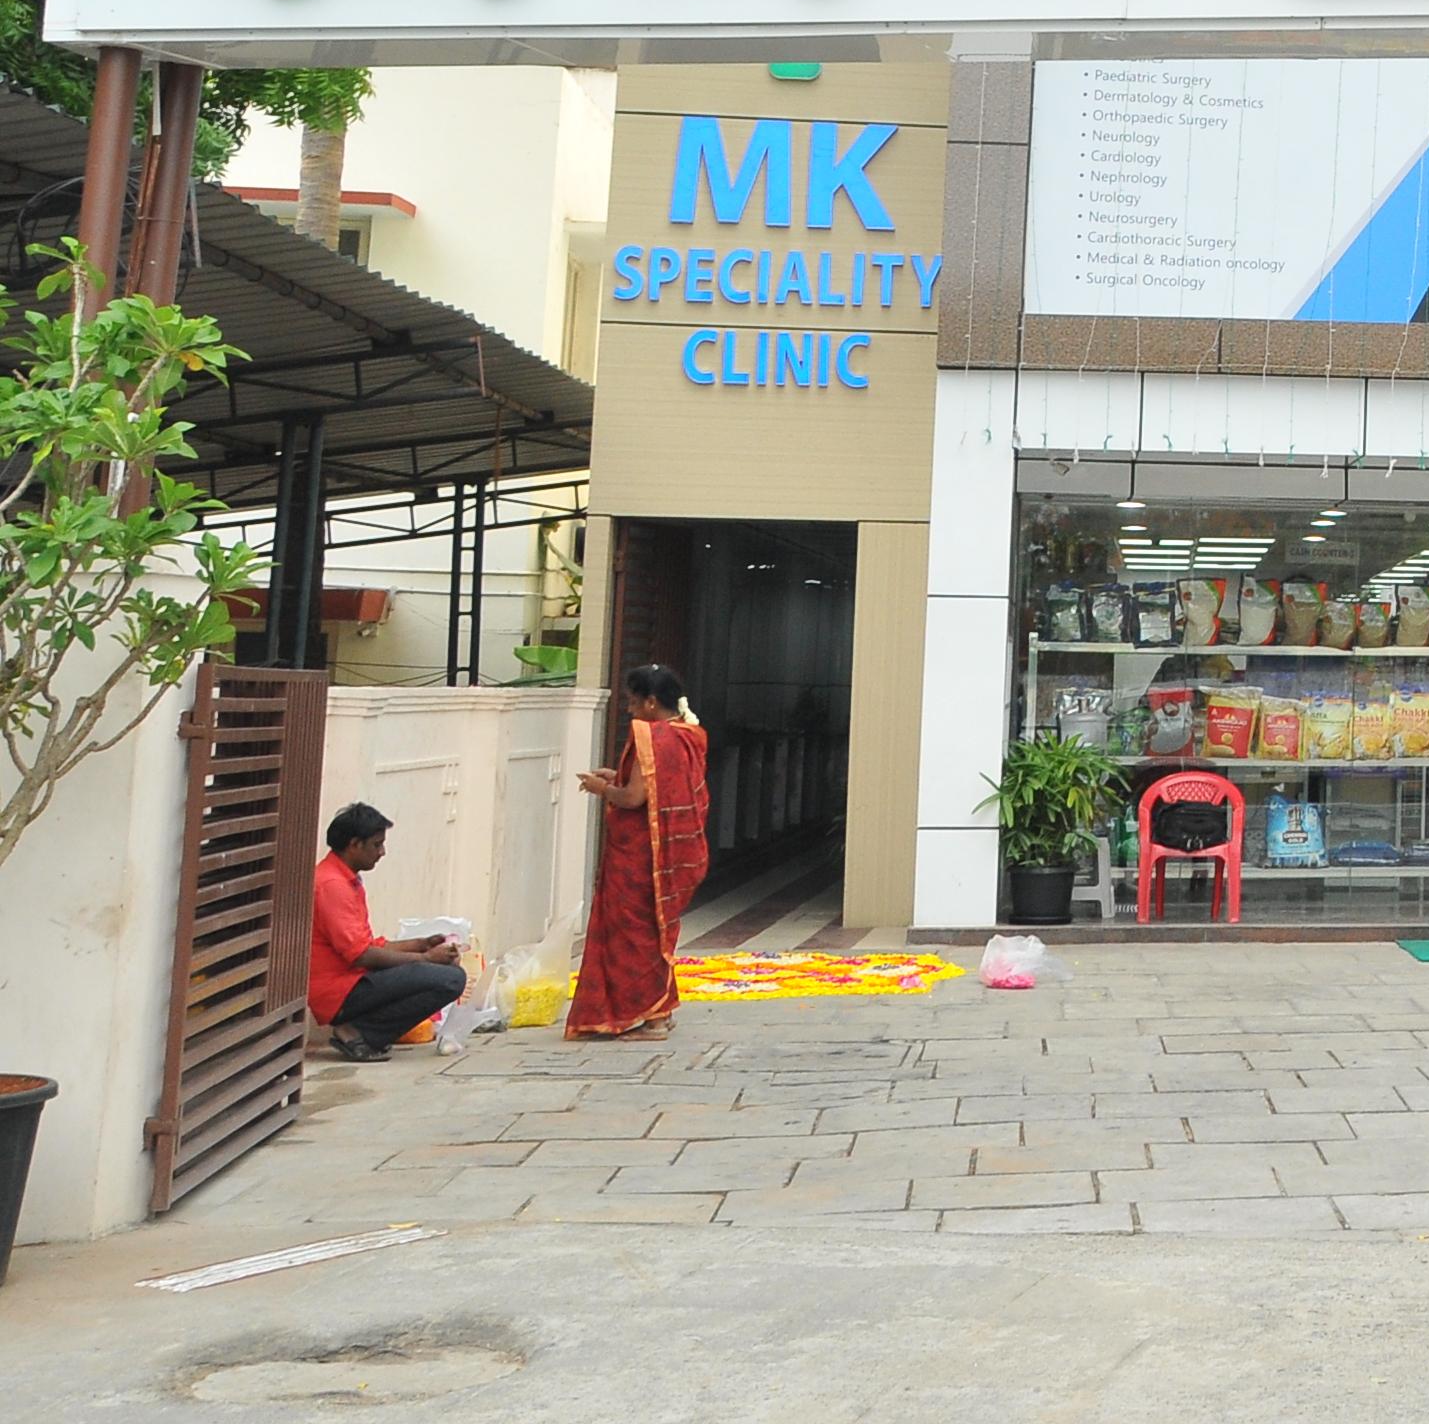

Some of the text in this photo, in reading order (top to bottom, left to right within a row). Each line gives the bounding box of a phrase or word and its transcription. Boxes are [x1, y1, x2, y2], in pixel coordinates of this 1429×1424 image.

[1095, 69, 1212, 89] Paediatric Surgery
[1094, 89, 1264, 109] Dermatology & Cosmetics
[1092, 109, 1228, 129] Orthopaedic Surgery
[1092, 130, 1160, 146] Neurology
[1090, 149, 1161, 166] Cardiology
[669, 114, 898, 231] MK
[1090, 170, 1168, 187] Nephrology
[1089, 190, 1142, 207] Urology
[1088, 211, 1178, 228] Neurosurgery
[1087, 231, 1237, 251] Cardiothoracic Surgery
[1087, 252, 1286, 273] Medical & Radiation oncology
[613, 244, 944, 309] SPECIALITY
[1086, 272, 1206, 290] Surgical Oncology
[682, 328, 871, 389] CLINIC
